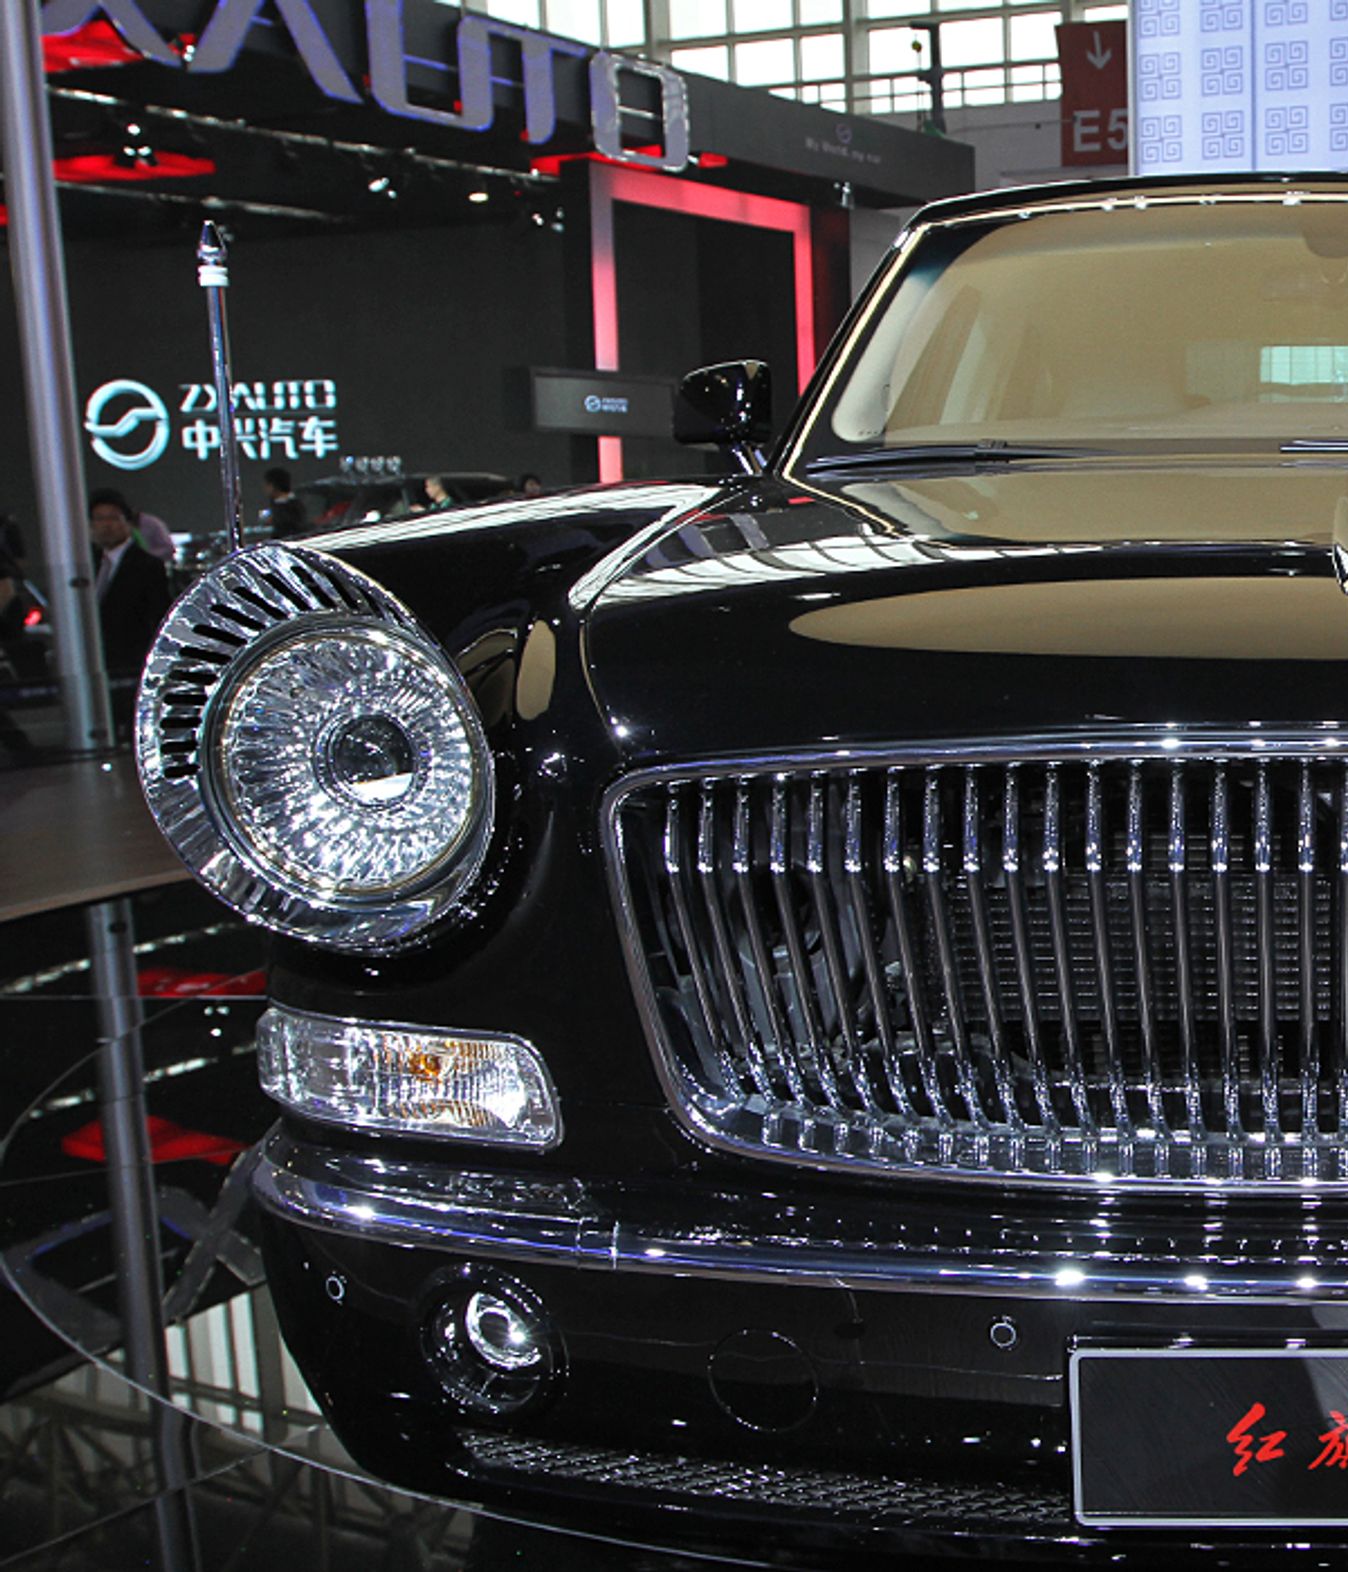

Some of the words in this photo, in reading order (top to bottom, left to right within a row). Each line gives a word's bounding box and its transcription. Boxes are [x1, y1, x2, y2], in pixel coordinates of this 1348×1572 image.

[1073, 108, 1128, 152] E5
[182, 416, 339, 460] 中兴汽车
